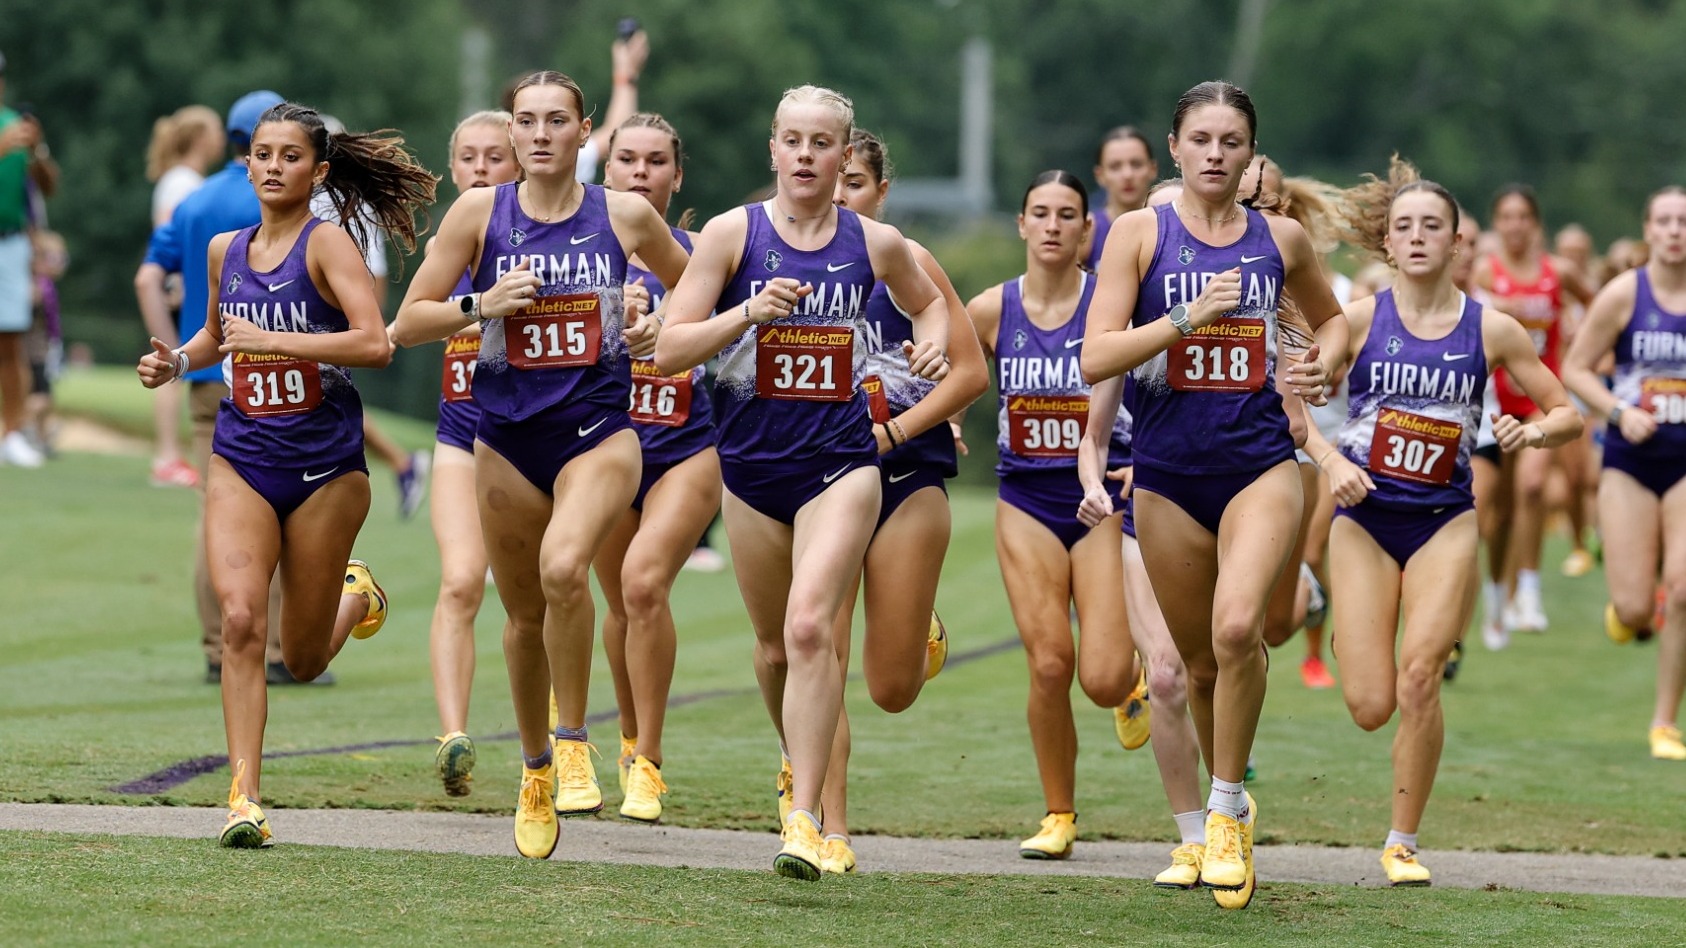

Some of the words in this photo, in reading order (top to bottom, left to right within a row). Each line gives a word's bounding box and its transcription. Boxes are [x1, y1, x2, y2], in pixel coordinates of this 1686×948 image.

[573, 301, 596, 310] NET
[750, 281, 863, 319] FMAN
[1164, 272, 1276, 310] FUAN
[523, 321, 586, 359] 315
[760, 328, 828, 344] Athletic
[829, 335, 851, 344] NET
[1192, 324, 1239, 336] hletic
[1240, 327, 1262, 336] NET
[1632, 331, 1686, 360] FURM
[451, 360, 477, 393] 31
[774, 353, 836, 389] 321
[1000, 356, 1084, 389] FURMA
[1185, 345, 1249, 381] 318
[247, 369, 306, 407] 319
[1369, 362, 1476, 405] FURMAN
[1009, 397, 1069, 411] Athletic
[1651, 393, 1686, 424] 30
[1023, 418, 1081, 449] 309
[1379, 411, 1440, 435] Athletic
[1384, 435, 1445, 475] 307
